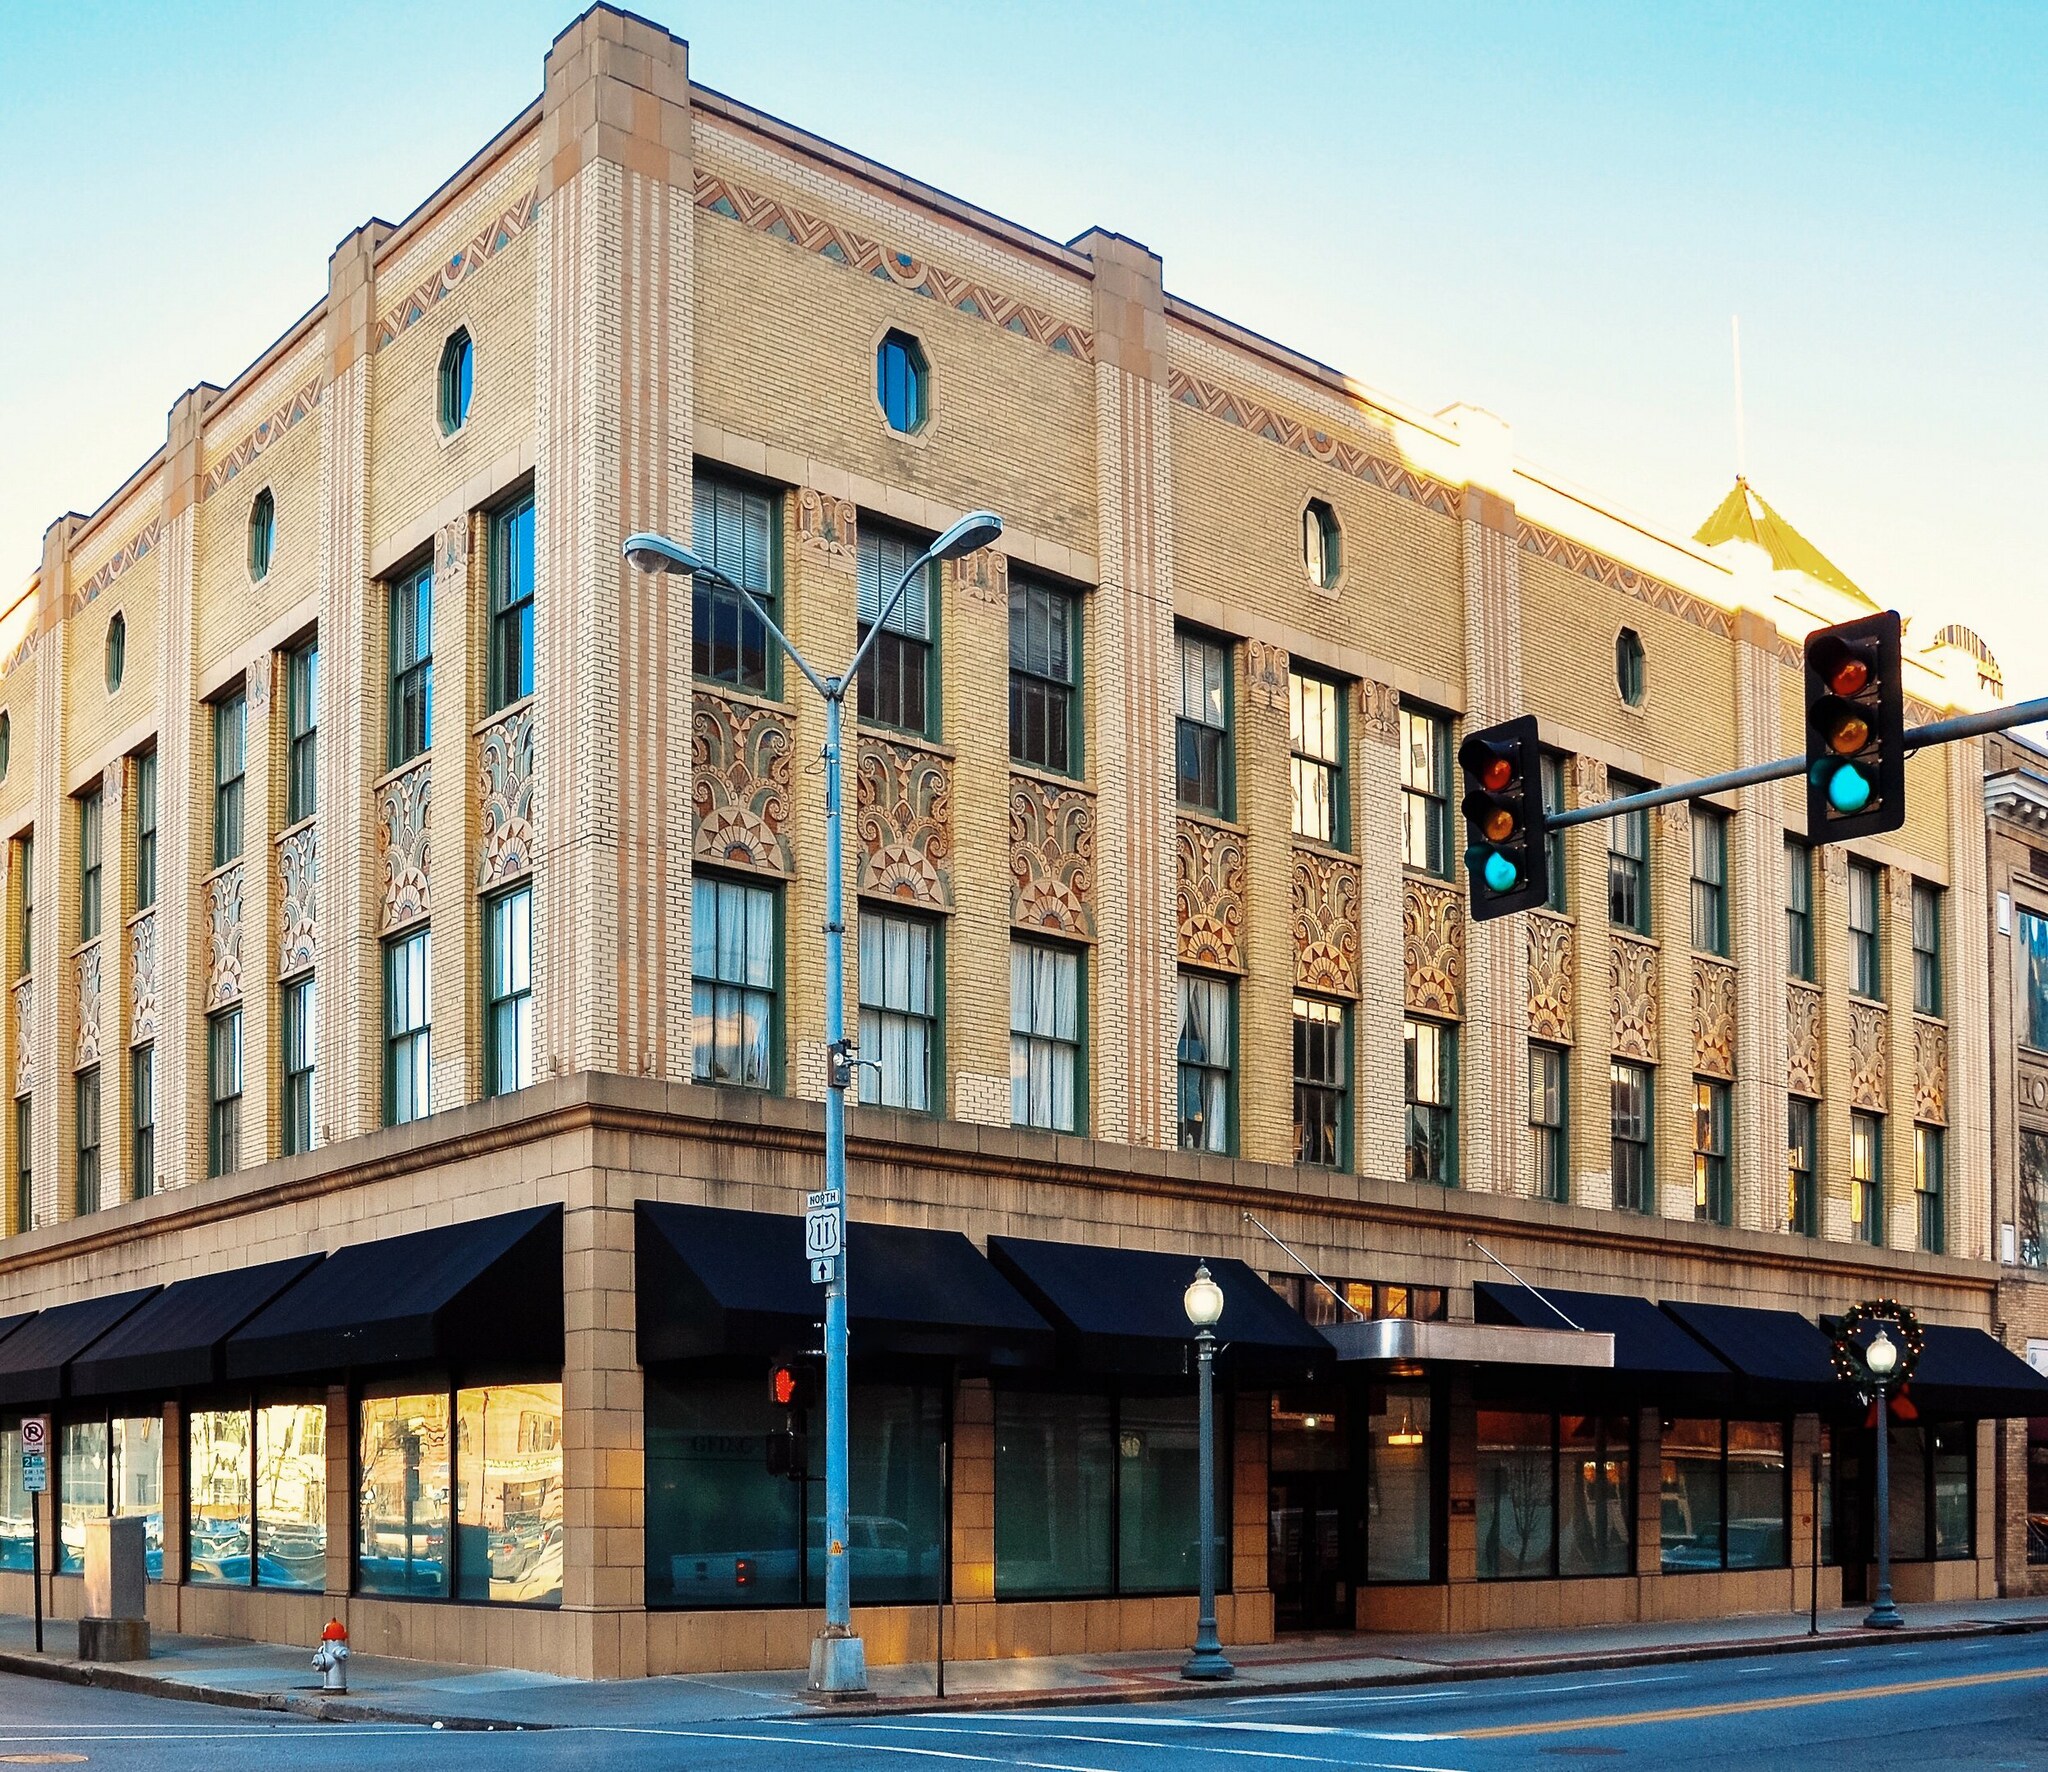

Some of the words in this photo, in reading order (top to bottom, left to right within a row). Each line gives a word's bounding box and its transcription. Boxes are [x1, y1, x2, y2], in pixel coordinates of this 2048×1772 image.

[809, 1192, 836, 1205] NORTH
[816, 1221, 829, 1246] 11
[24, 1457, 31, 1467] 2
